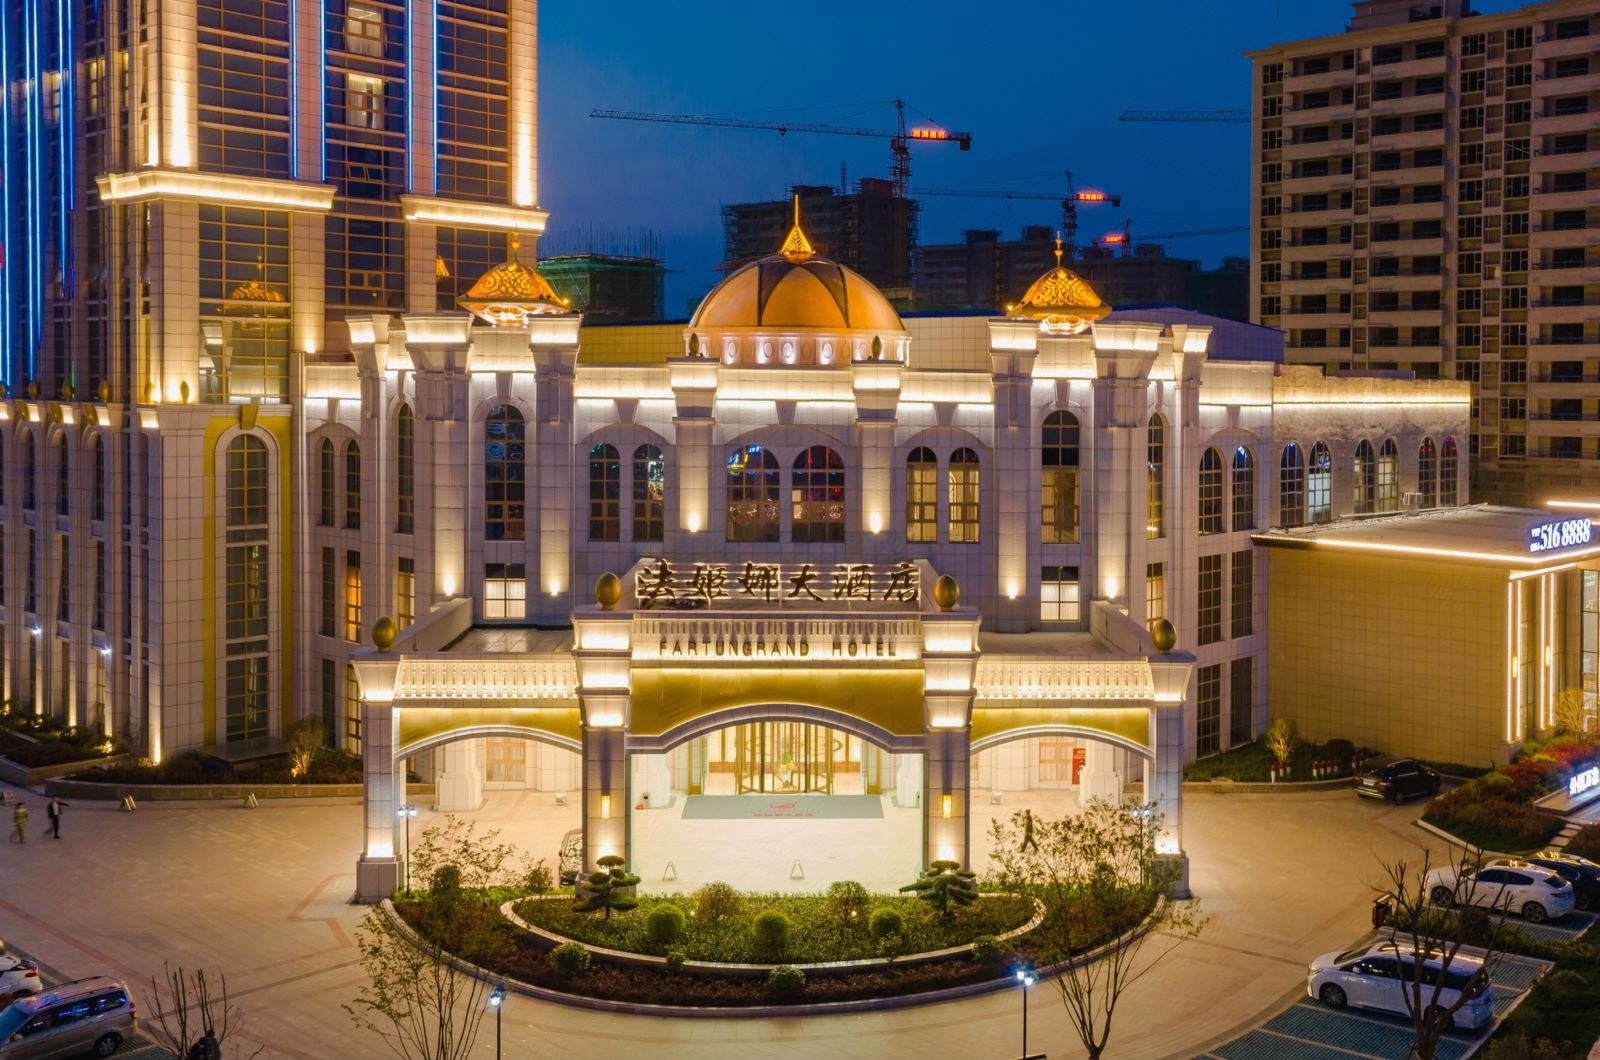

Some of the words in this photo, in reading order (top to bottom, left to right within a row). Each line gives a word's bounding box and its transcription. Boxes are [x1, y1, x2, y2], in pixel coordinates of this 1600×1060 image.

[1541, 522, 1561, 550] 516
[1562, 518, 1591, 546] 8888
[660, 640, 809, 656] FARTUNGRAND
[832, 640, 896, 656] HOTEL
